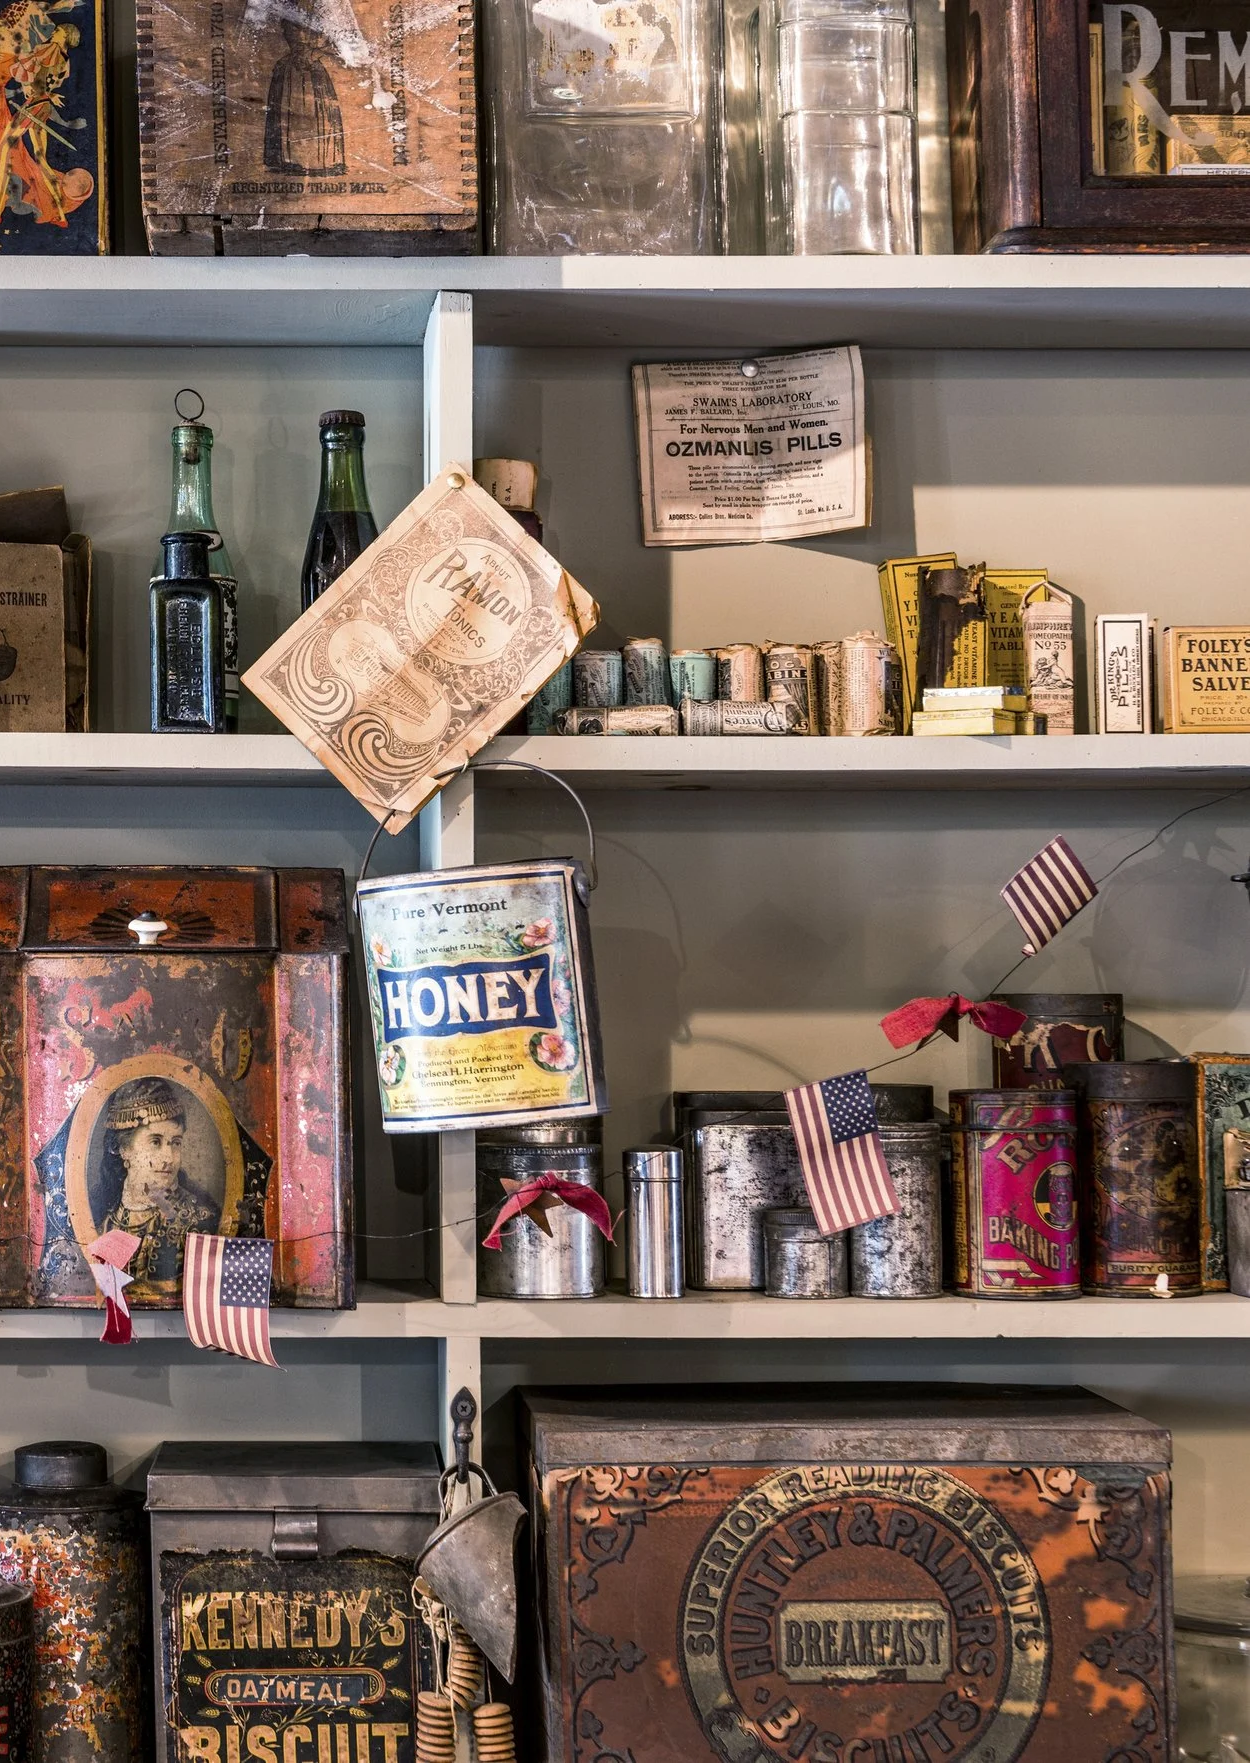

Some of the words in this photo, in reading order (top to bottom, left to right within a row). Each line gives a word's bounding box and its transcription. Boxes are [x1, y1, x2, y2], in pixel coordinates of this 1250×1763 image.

[211, 3, 224, 39] 1780
[232, 182, 303, 194] REGISTERED
[307, 182, 346, 194] TRADE
[693, 398, 737, 406] SWAIM'S
[742, 392, 812, 407] LABORATORY
[803, 402, 825, 410] LOUIS,
[680, 424, 697, 434] For
[701, 423, 740, 435] Nervous
[744, 423, 764, 434] Men
[768, 421, 785, 432] and
[789, 418, 828, 429] Women.
[666, 440, 773, 457] OZMANLIS
[788, 432, 842, 453] PILLS
[480, 554, 512, 581] ABOUT
[0, 591, 48, 607] STRAINER
[423, 548, 523, 626] RAMON
[444, 598, 486, 649] TONICS
[964, 644, 968, 653] NO
[1053, 641, 1067, 650] 55
[1108, 650, 1118, 684] KING'S
[1116, 645, 1129, 707] PILLS
[1193, 677, 1250, 691] SALVE
[1230, 707, 1236, 715] &
[392, 907, 425, 921] Pure
[432, 899, 508, 917] Vermont
[431, 944, 459, 955] Weight
[383, 968, 546, 1029] HONEY
[418, 1059, 452, 1068] Produced
[471, 1055, 500, 1063] Packed
[504, 1054, 514, 1062] by
[450, 1068, 462, 1076] H.
[464, 1062, 525, 1075] Harrington
[475, 1074, 516, 1083] Vermont
[988, 1216, 1062, 1272] BAKING
[685, 1493, 777, 1658] SUPERIOR
[778, 1465, 940, 1502] READING
[944, 1494, 1046, 1652] BISCUITS
[730, 1506, 842, 1681] HUNTLEY
[848, 1502, 881, 1547] &
[884, 1509, 998, 1679] PALMERS
[180, 1587, 408, 1651] KENNEDY'S
[784, 1619, 945, 1667] BREAKFAST
[226, 1678, 350, 1703] OATMEAL
[756, 1691, 981, 1763] BISCUITS
[179, 1721, 410, 1763] BISCUIT
